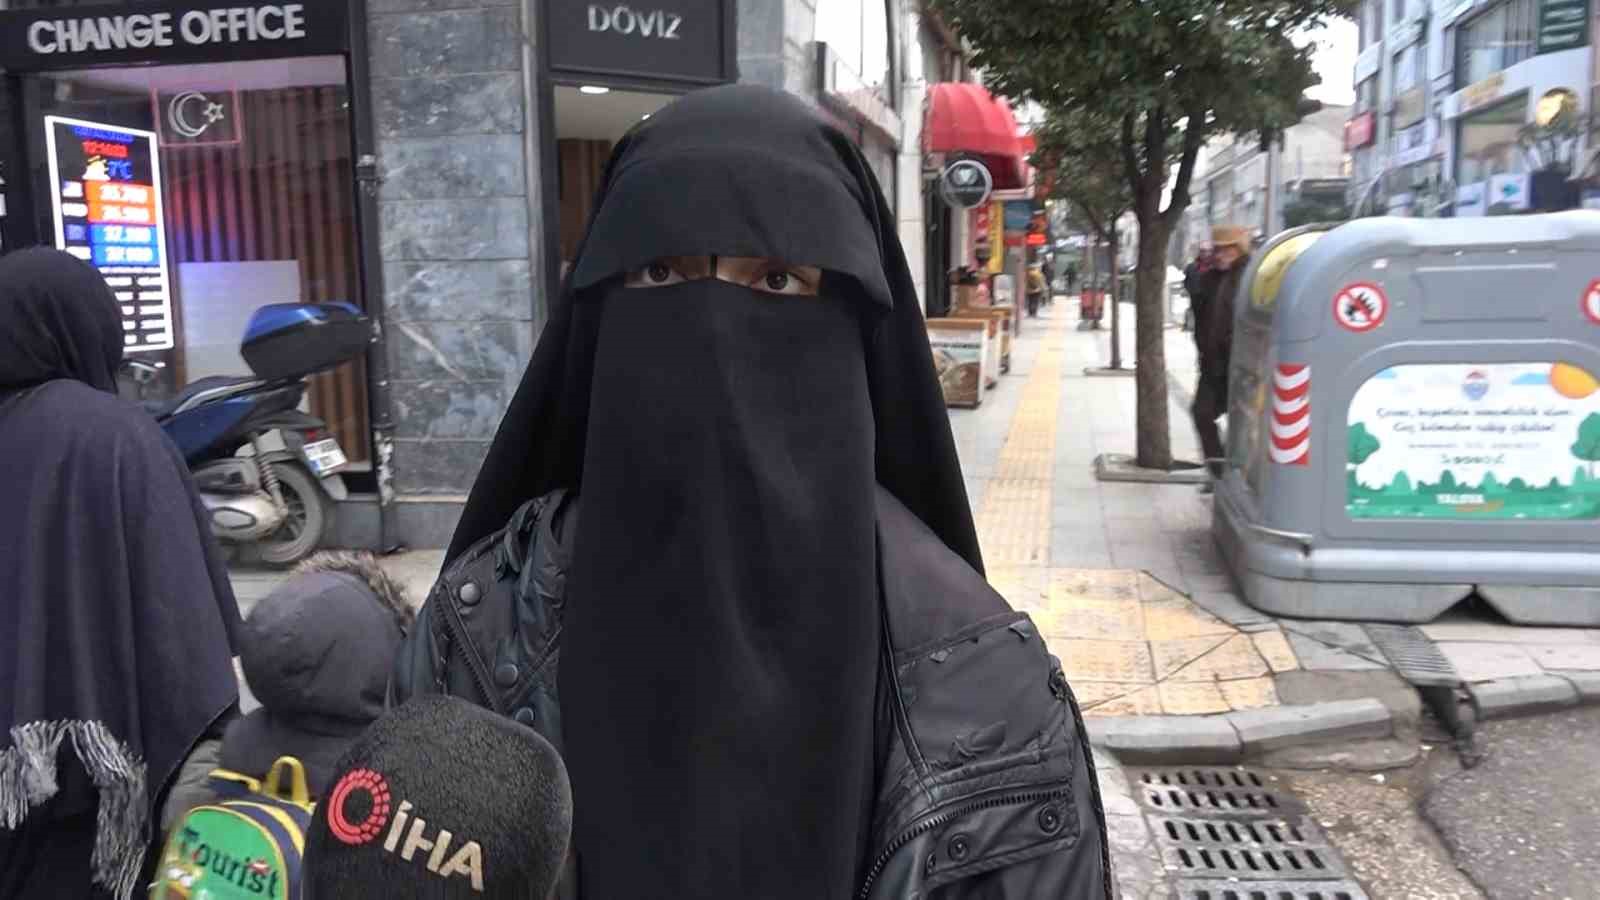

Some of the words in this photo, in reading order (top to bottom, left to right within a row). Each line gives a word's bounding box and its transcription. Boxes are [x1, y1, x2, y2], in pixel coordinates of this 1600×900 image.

[28, 13, 174, 54] CHANGE
[180, 4, 306, 45] OFFICE
[177, 825, 280, 898] Tourist
